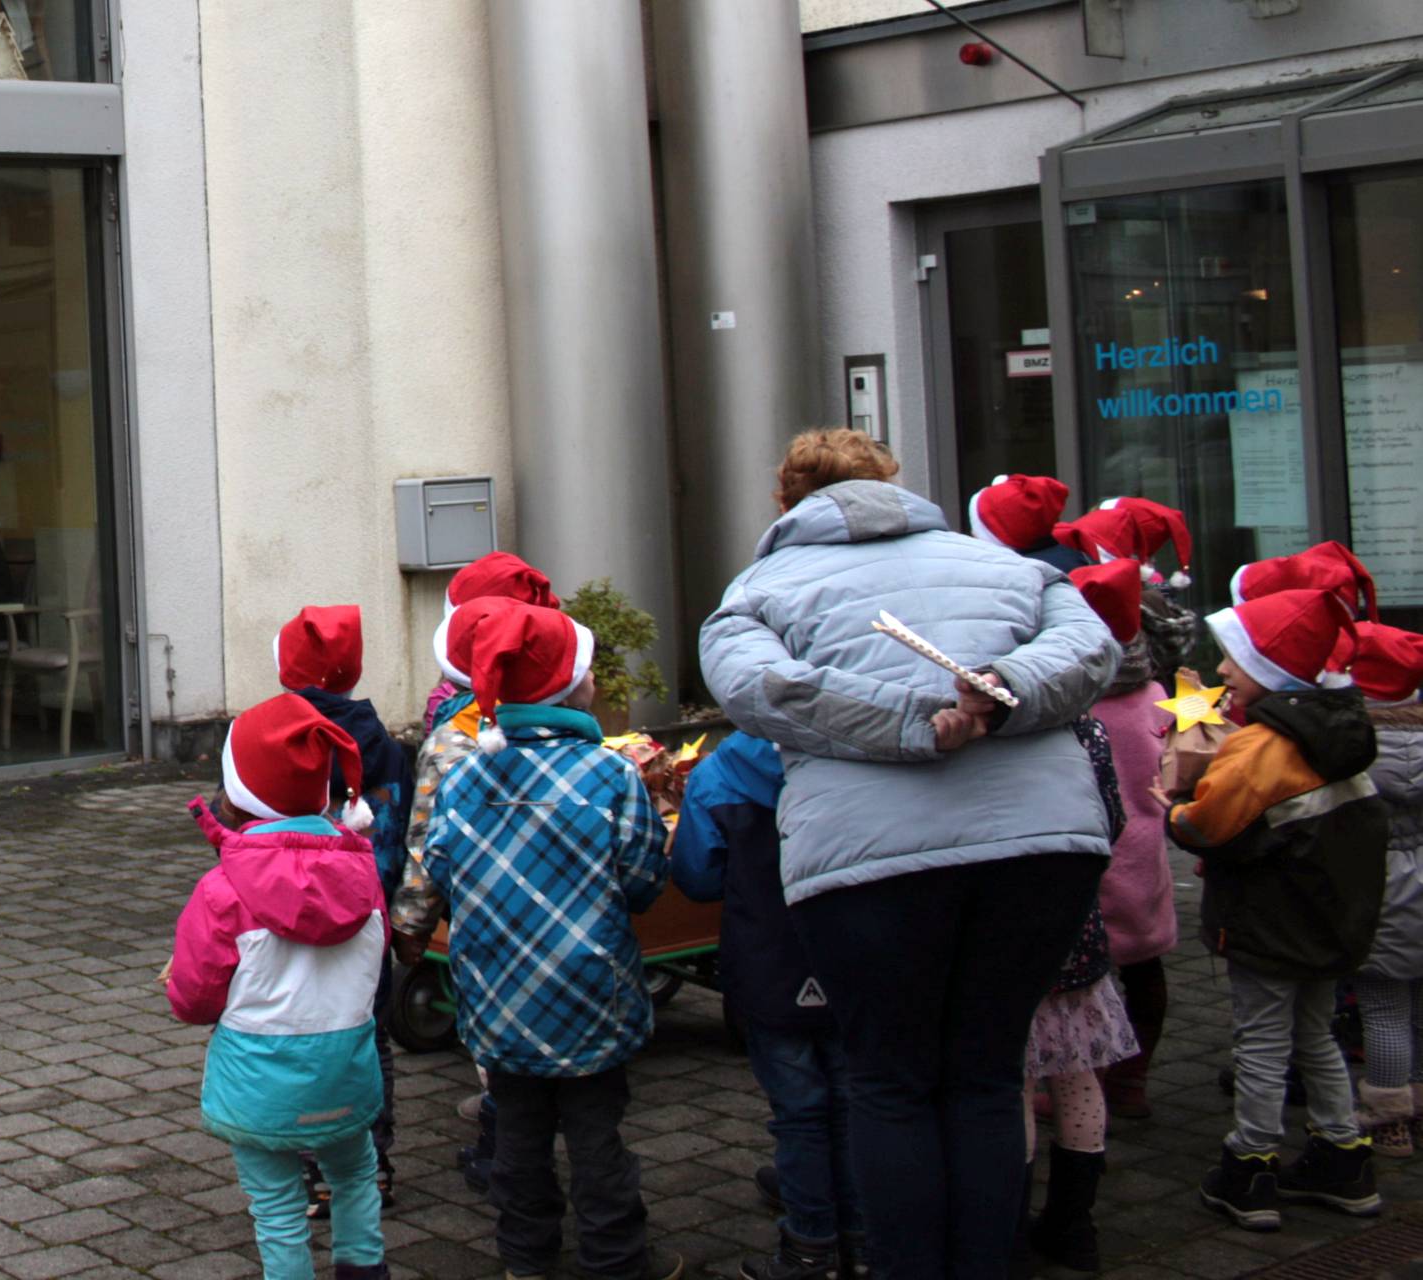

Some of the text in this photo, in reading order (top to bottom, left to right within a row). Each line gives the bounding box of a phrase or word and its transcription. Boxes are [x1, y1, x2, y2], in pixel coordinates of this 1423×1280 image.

[1023, 357, 1050, 368] BMZ
[1095, 336, 1218, 370] Herzlich
[1097, 387, 1282, 419] willkommen
